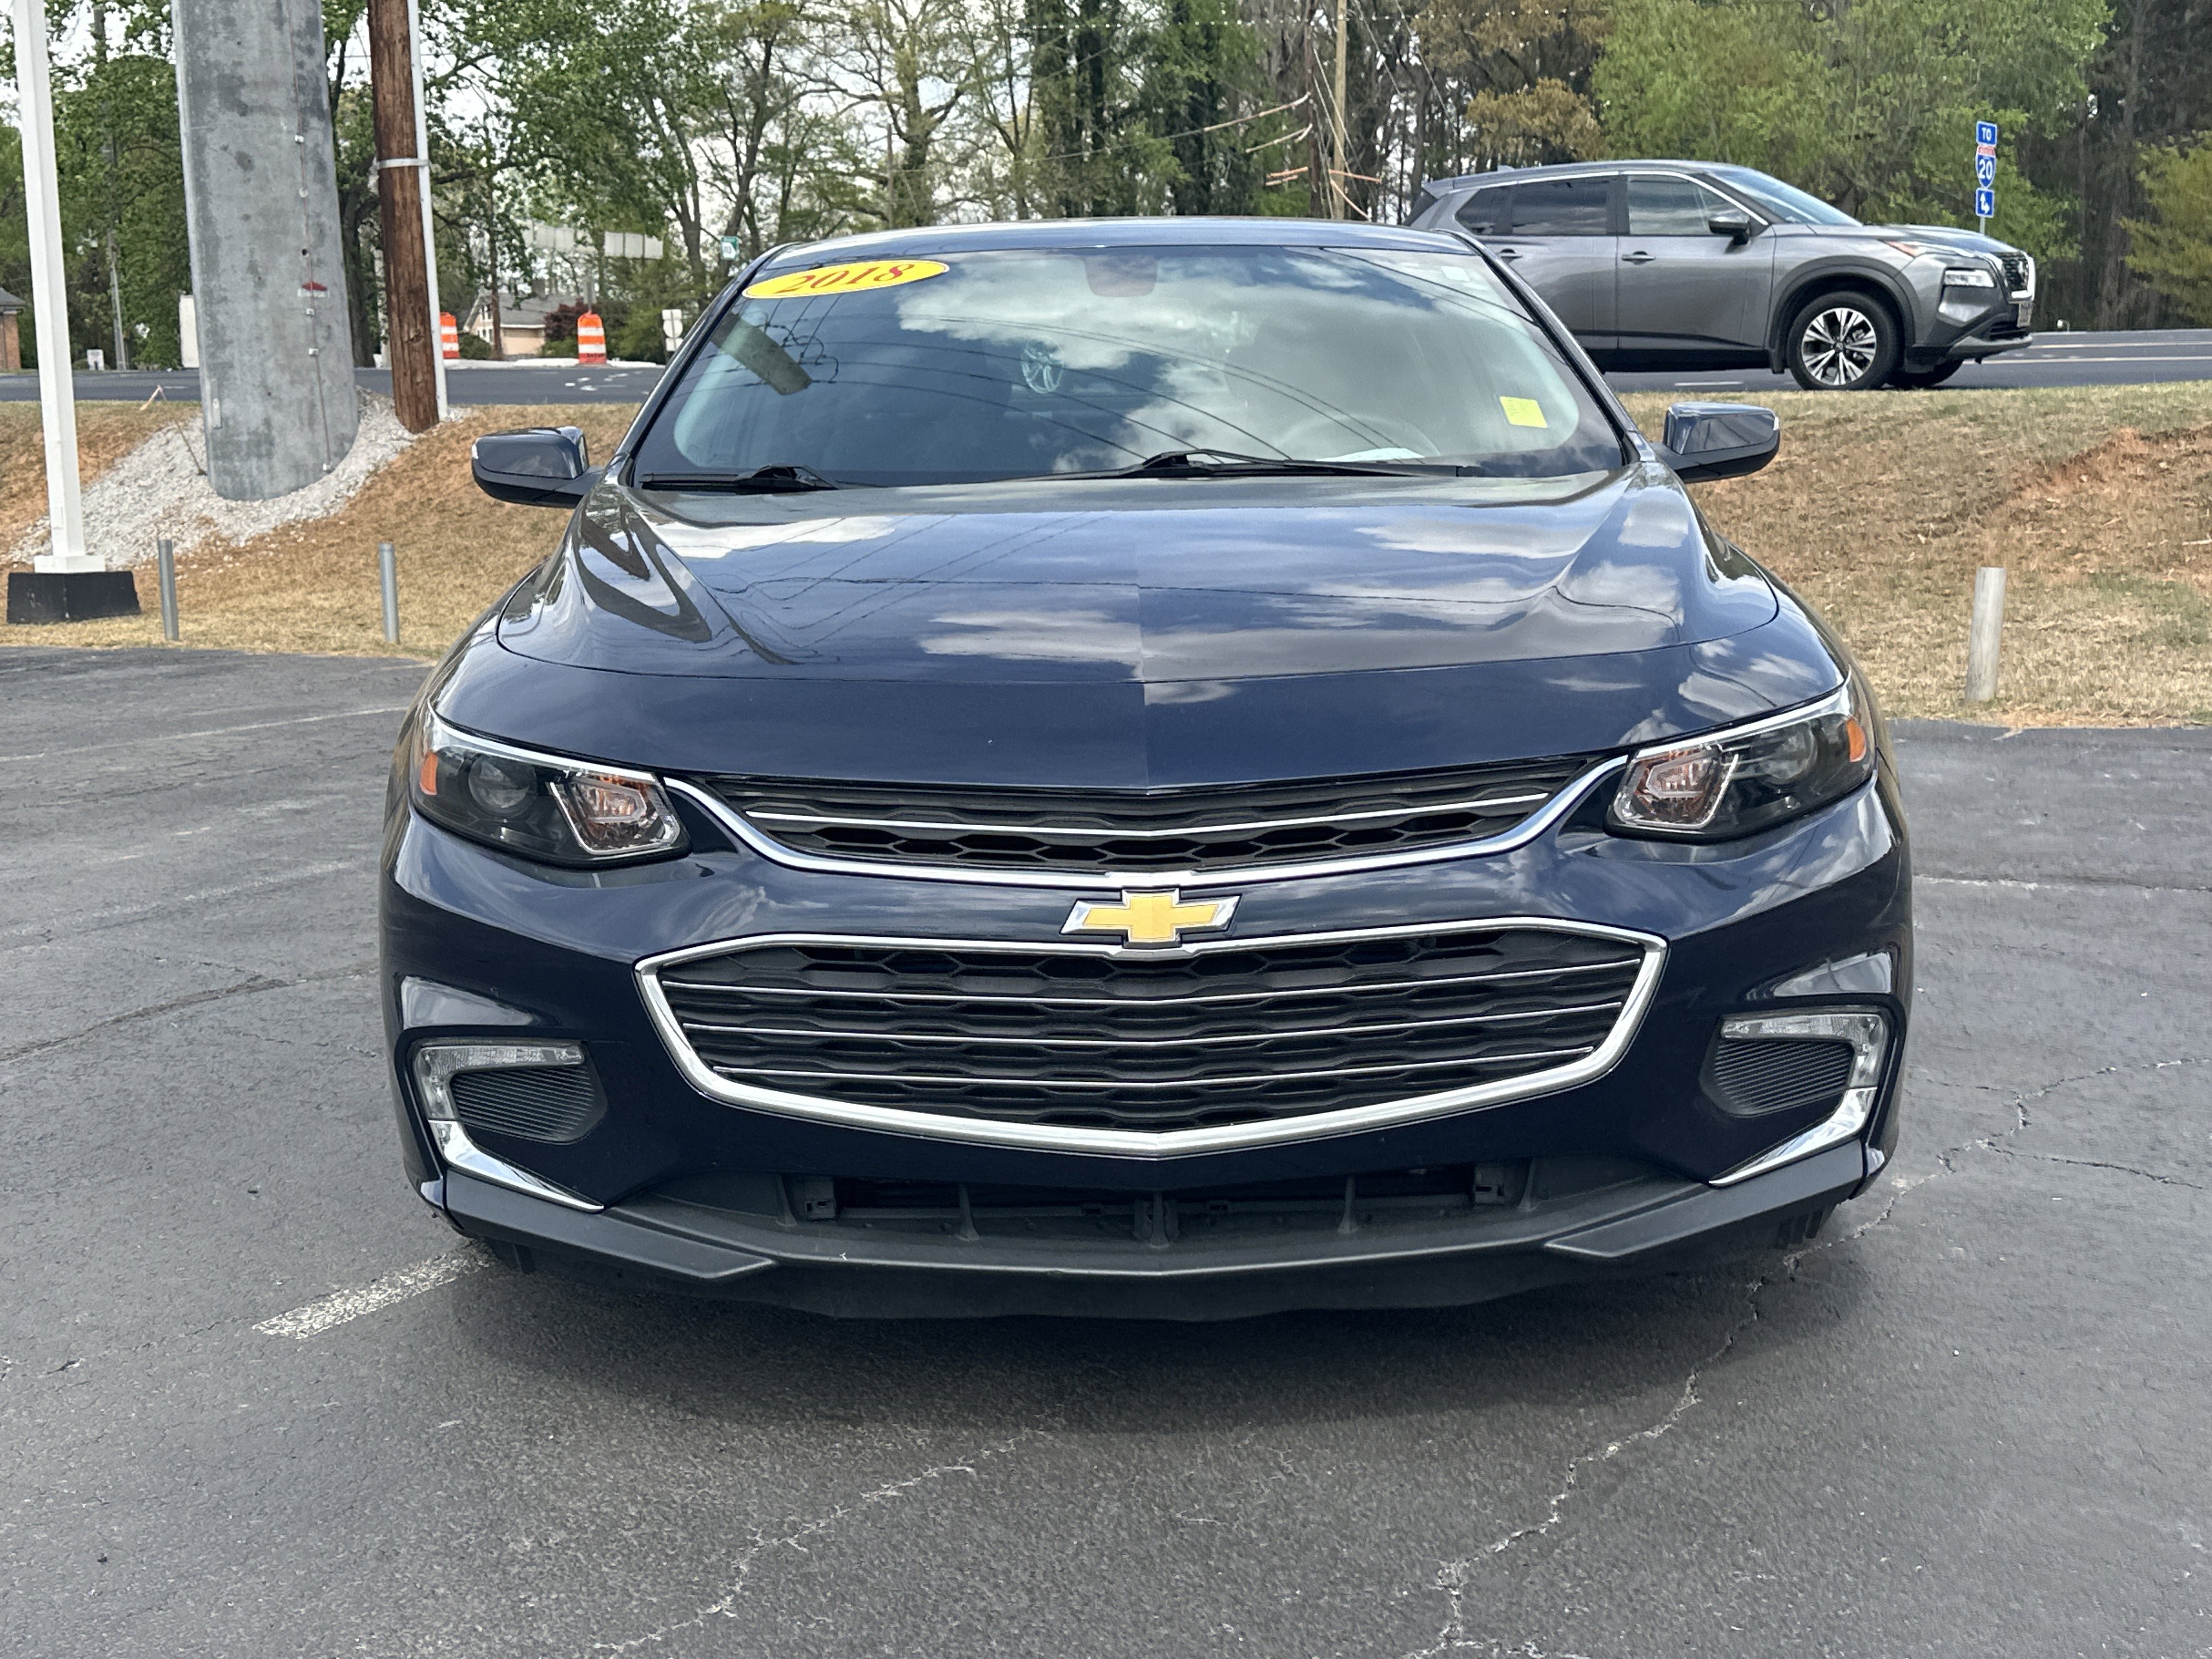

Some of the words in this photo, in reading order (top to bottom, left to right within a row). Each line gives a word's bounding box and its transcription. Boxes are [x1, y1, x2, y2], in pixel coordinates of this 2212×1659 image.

[1982, 127, 1992, 141] TO
[1978, 159, 1993, 180] 20
[773, 264, 916, 294] 2018
